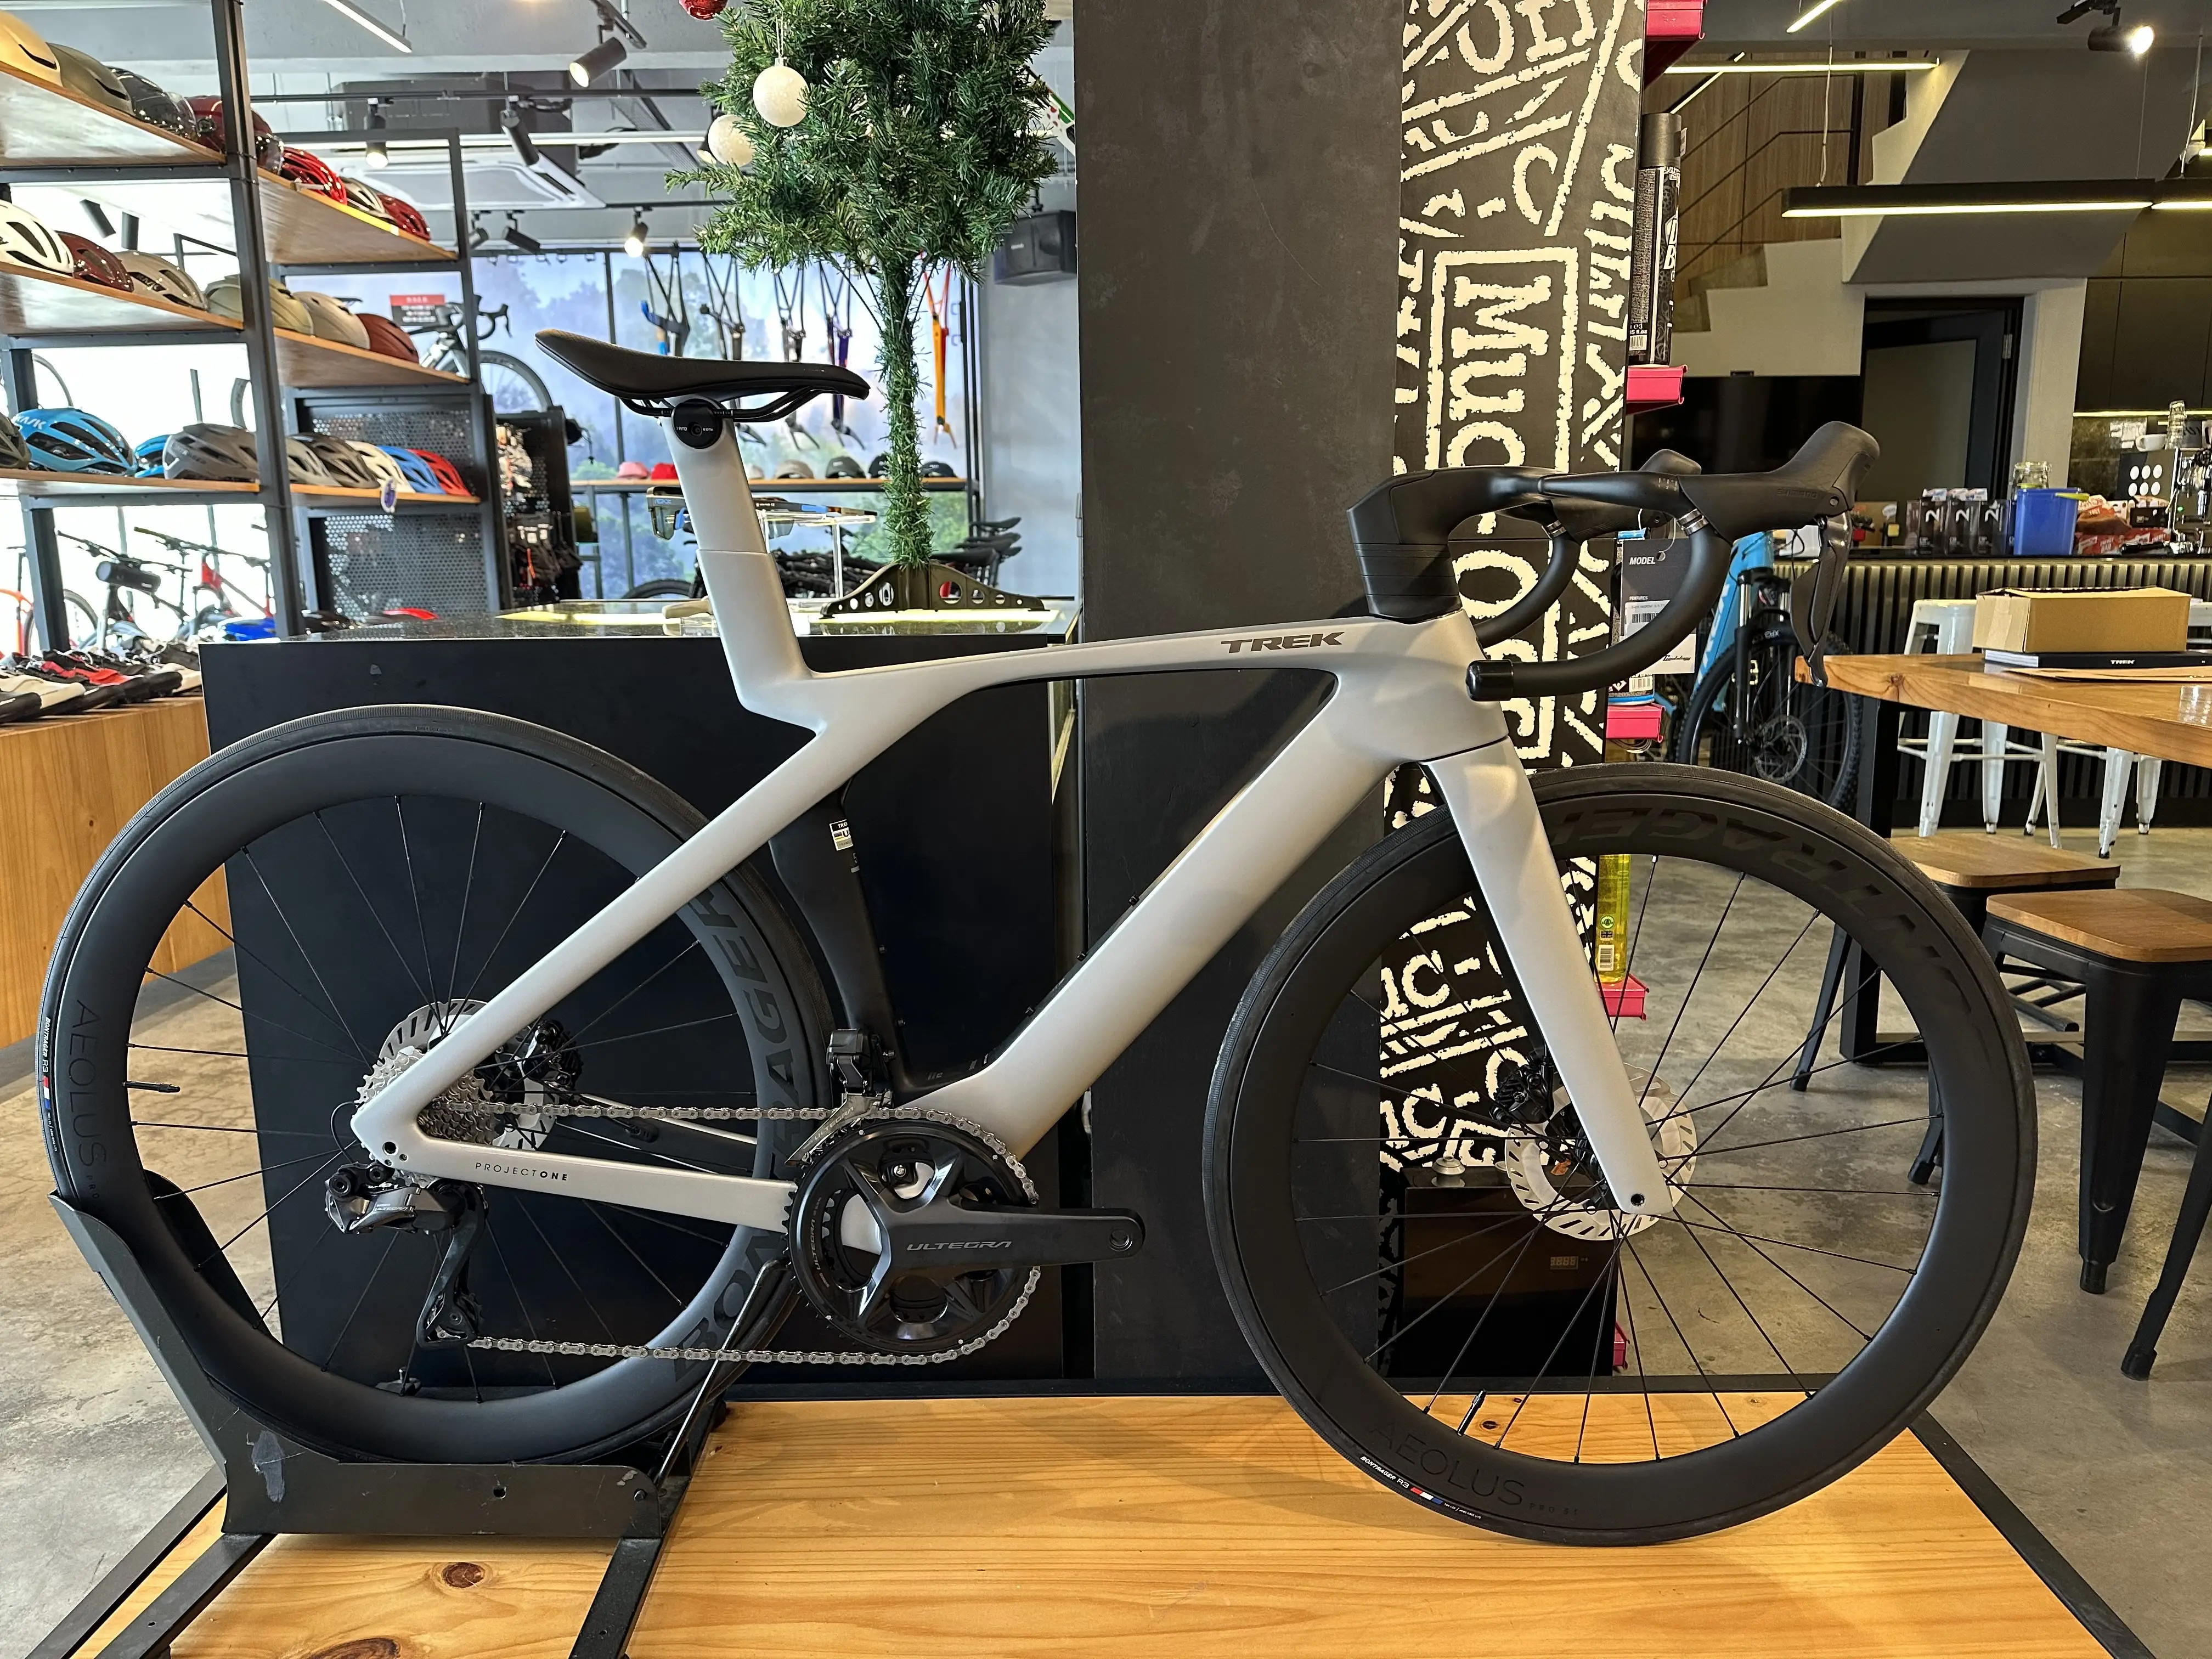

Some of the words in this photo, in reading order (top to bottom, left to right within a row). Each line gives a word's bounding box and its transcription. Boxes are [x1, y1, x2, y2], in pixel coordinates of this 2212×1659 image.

[1629, 556, 1656, 566] MODEL
[1221, 631, 1345, 653] TREK
[42, 1017, 51, 1057] BONTRAGER
[42, 1058, 49, 1073] R3
[69, 999, 108, 1167] AEOLUS
[814, 1107, 854, 1141] ULTEGRA
[810, 1218, 821, 1271] ULTEGRA
[906, 1241, 1012, 1251] ULTEGRA
[1360, 1455, 1396, 1481] BONTRAGER
[1396, 1479, 1409, 1489] R3
[1369, 1421, 1525, 1505] AEOLUS
